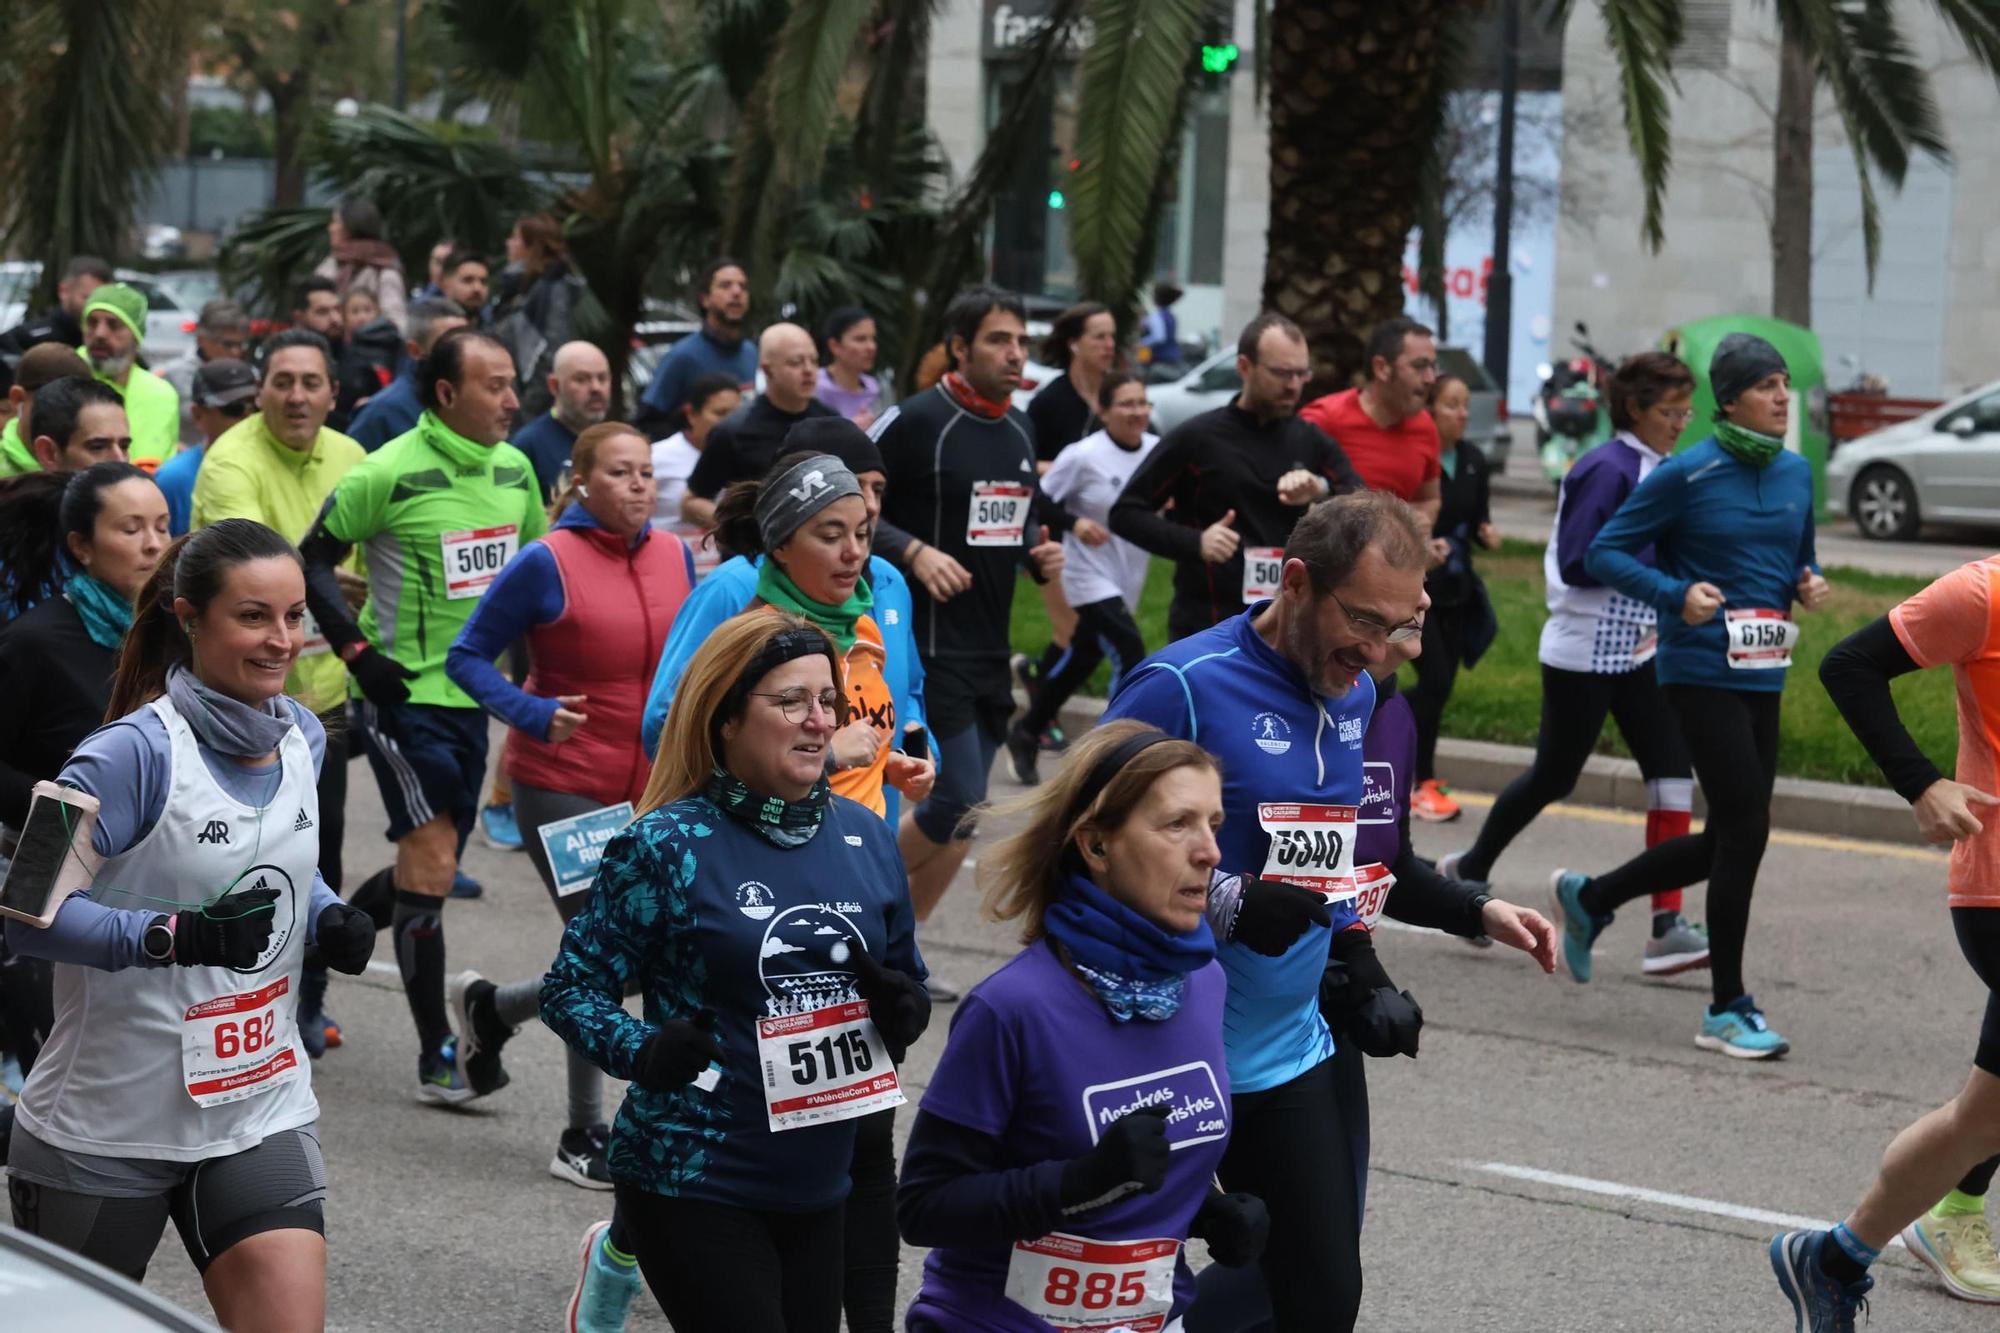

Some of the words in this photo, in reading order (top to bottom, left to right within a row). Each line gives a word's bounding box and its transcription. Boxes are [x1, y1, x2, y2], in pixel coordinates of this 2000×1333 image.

[457, 542, 507, 573] 5067
[1256, 562, 1279, 584] 50
[1276, 830, 1343, 870] 5340
[215, 1008, 276, 1060] 682
[788, 1029, 873, 1085] 5115
[806, 1086, 870, 1105] #ValènciaCorre
[1196, 1119, 1225, 1132] .com
[1044, 1266, 1146, 1310] 885
